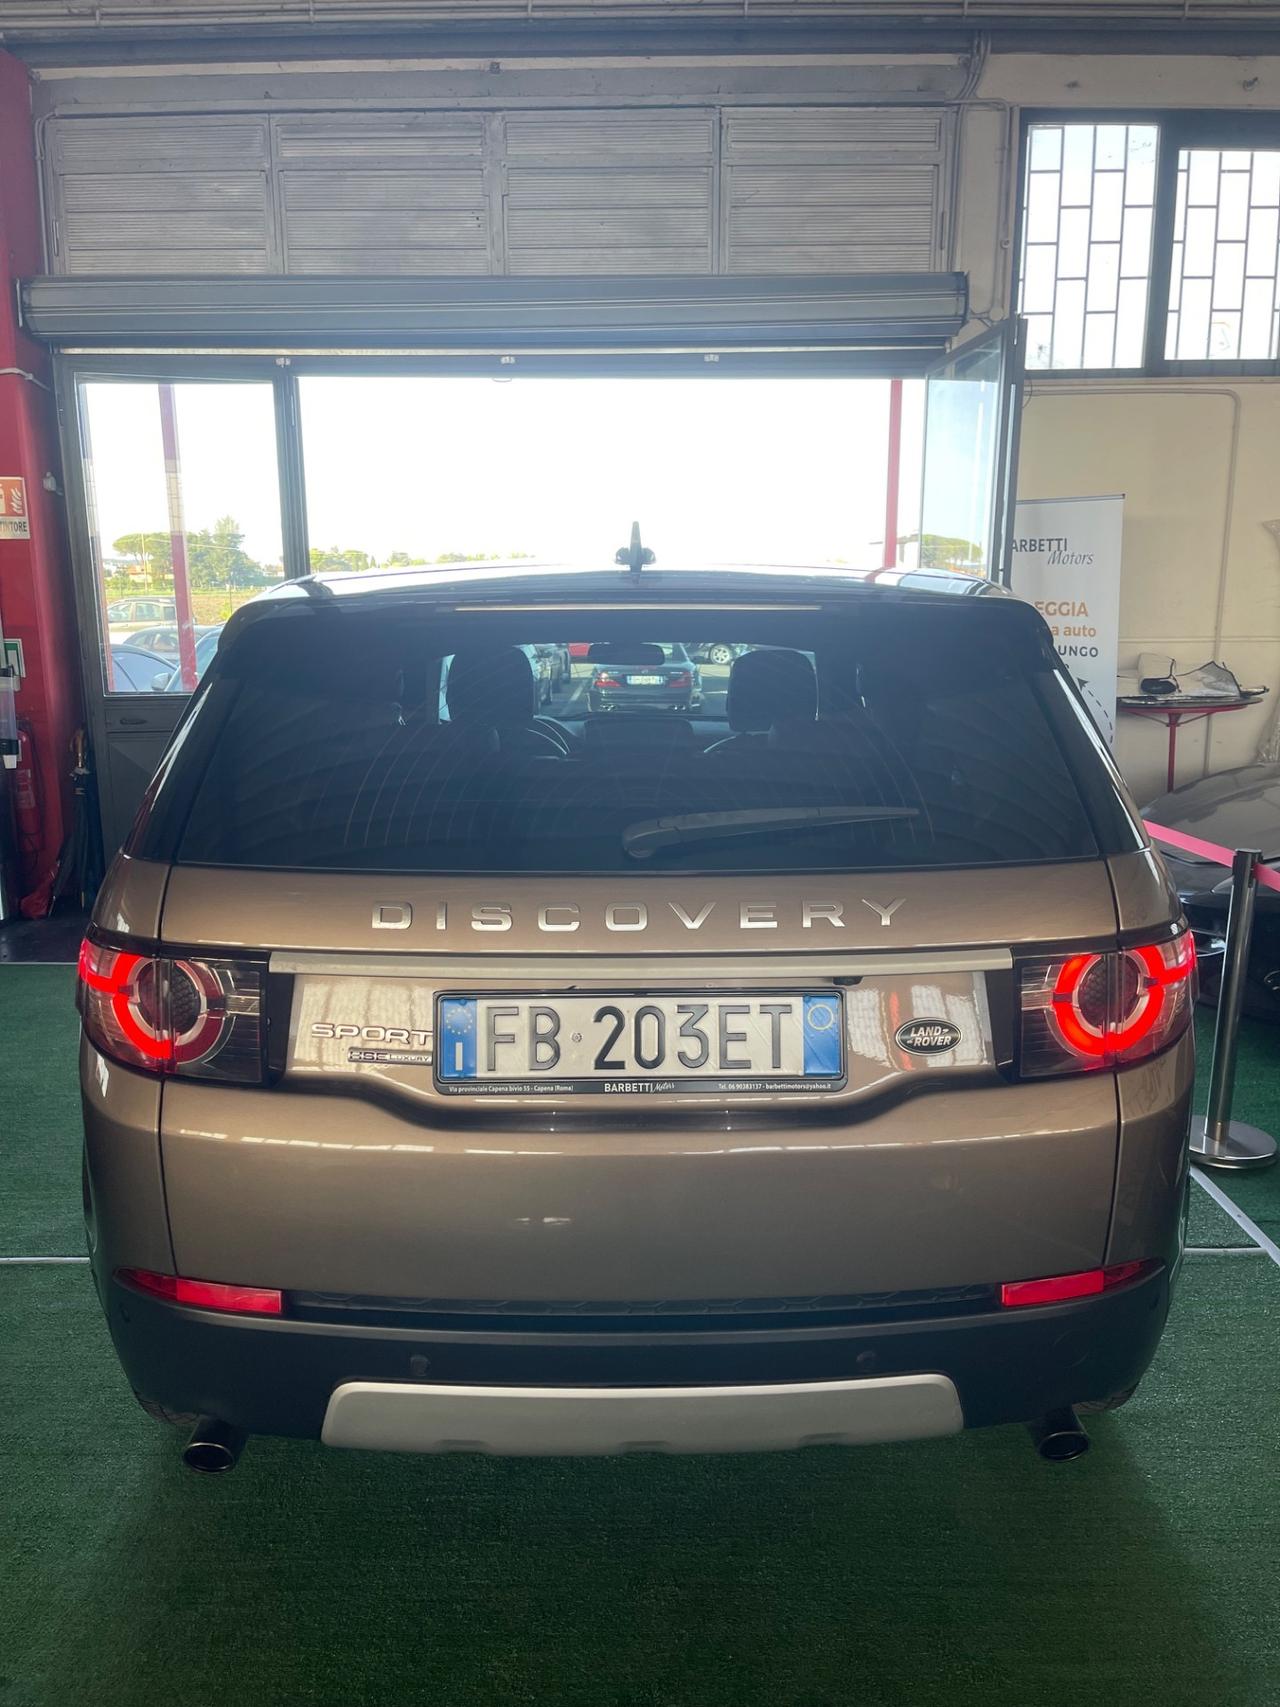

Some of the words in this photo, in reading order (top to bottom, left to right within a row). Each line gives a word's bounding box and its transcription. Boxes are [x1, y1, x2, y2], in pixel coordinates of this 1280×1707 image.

[1012, 538, 1068, 552] ARBETTI
[1047, 550, 1095, 566] Motors
[1034, 601, 1089, 617] EGGIA
[1063, 625, 1097, 638] auto
[1058, 645, 1099, 658] UNGO
[371, 899, 906, 932] DISCOVERY
[311, 1022, 433, 1046] SPORT
[486, 1006, 561, 1071] FB
[593, 1003, 793, 1070] 203ET
[910, 1026, 941, 1037] LAND
[913, 1035, 952, 1046] ROVER
[349, 1051, 388, 1061] HSE
[534, 1085, 554, 1093] Capena
[604, 1082, 653, 1092] BARBETTI
